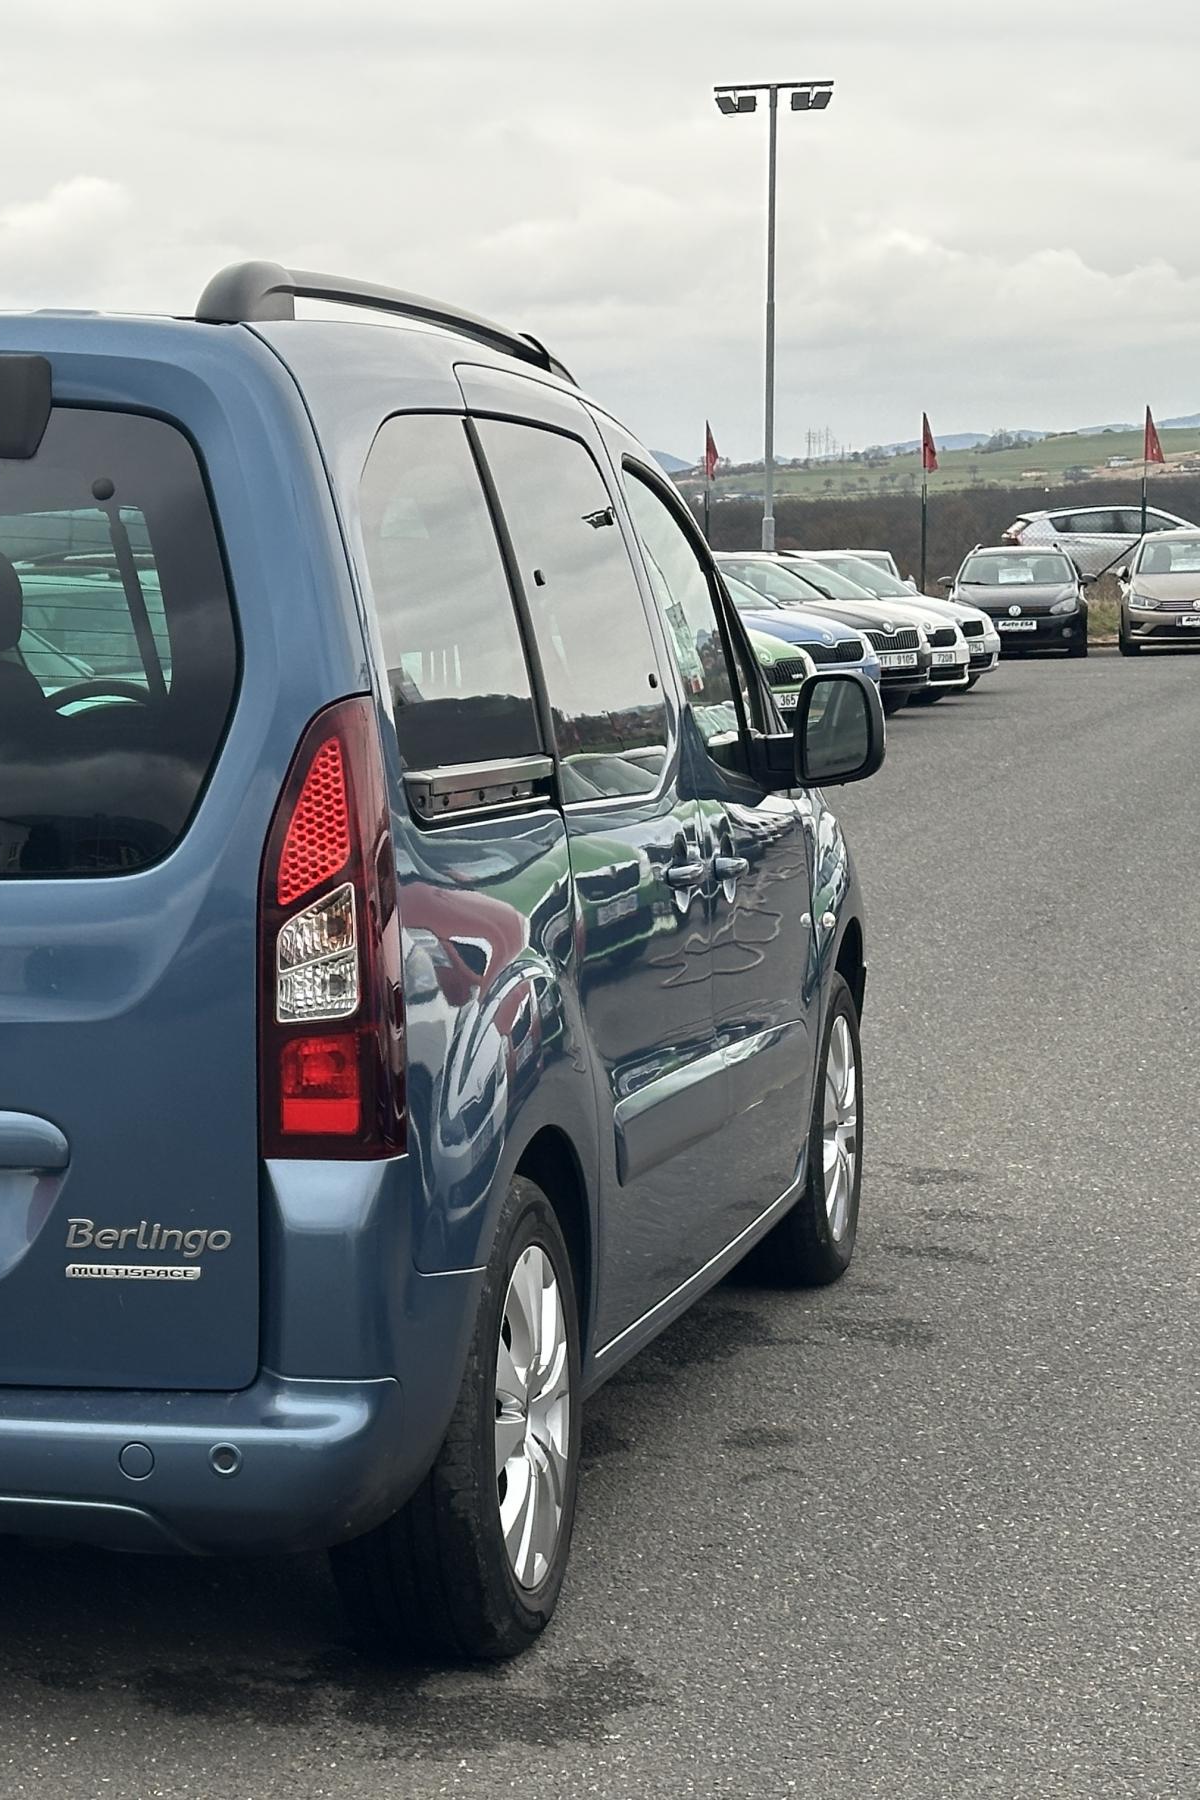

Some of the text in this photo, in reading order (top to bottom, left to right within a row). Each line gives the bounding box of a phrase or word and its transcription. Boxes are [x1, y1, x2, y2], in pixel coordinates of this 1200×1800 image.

[780, 694, 800, 707] 365
[65, 1218, 232, 1258] Berlingo
[71, 1265, 195, 1279] MULTISPACE
